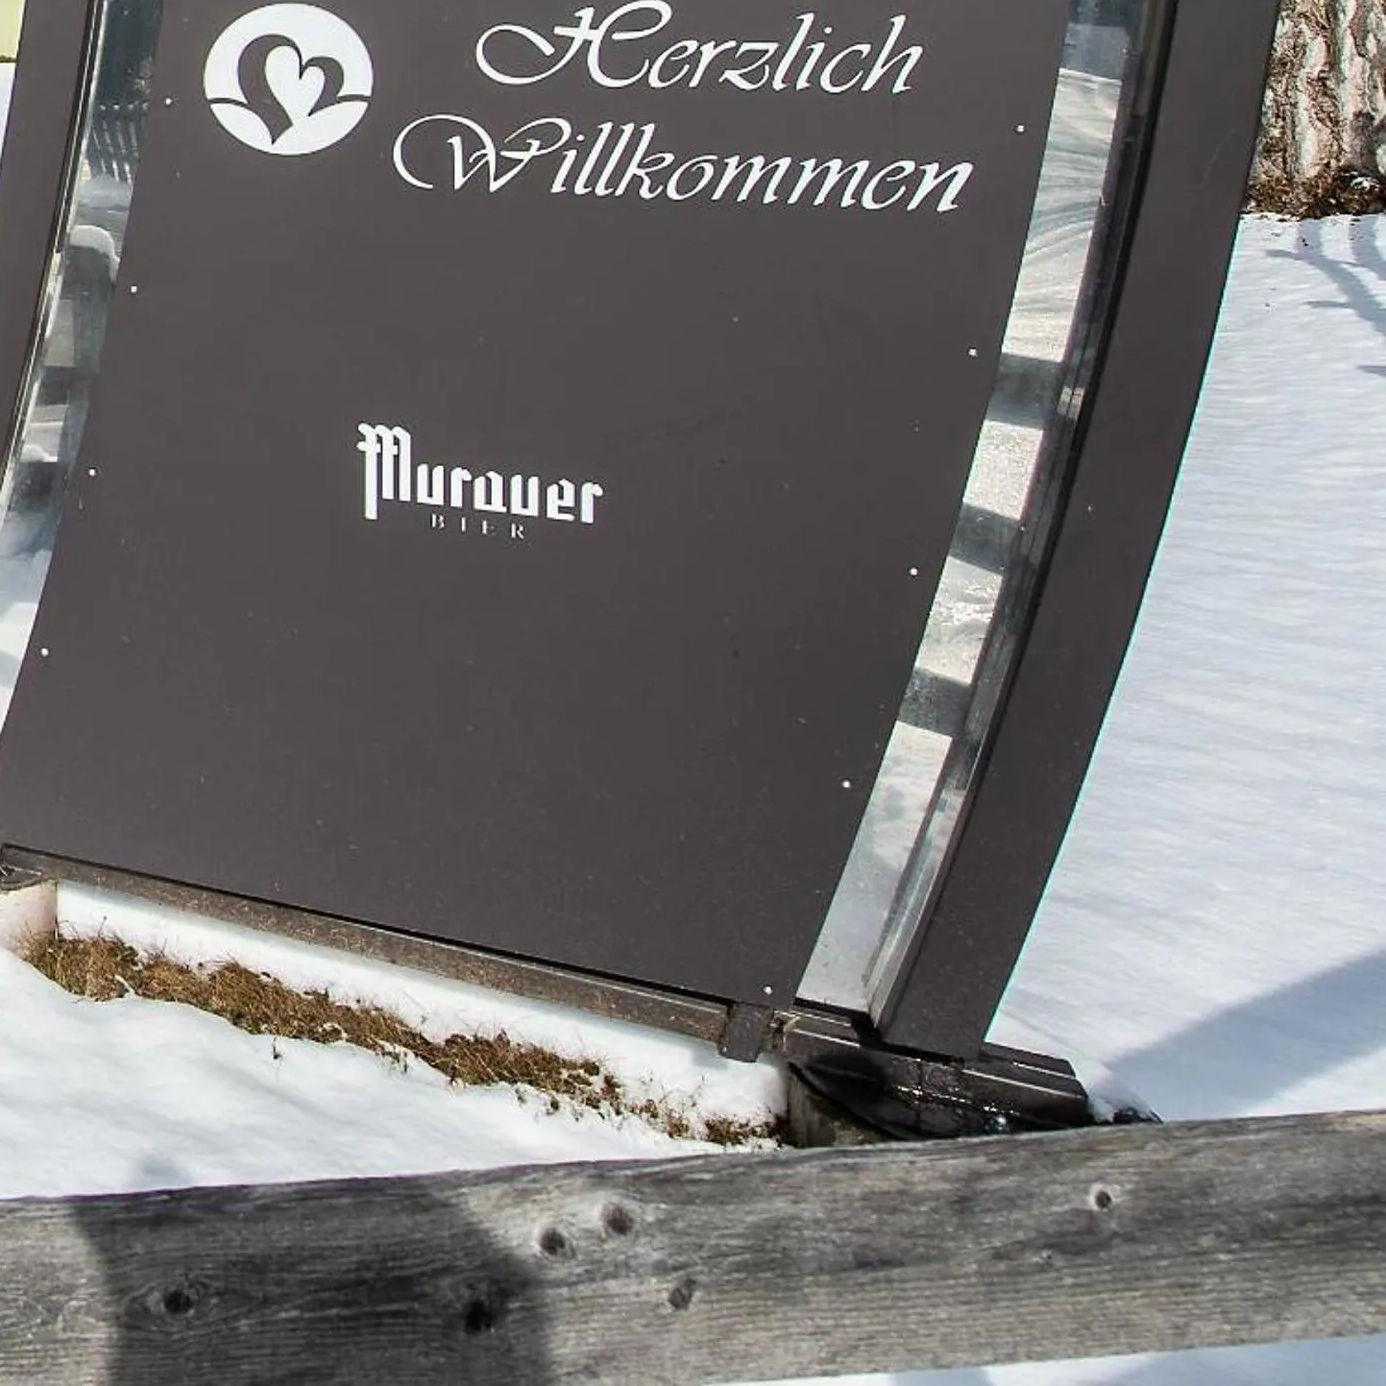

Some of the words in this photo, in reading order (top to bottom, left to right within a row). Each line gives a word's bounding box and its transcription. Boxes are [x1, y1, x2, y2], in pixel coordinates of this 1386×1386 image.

[475, 0, 923, 94] Herzlich
[392, 114, 973, 213] Willkommen
[356, 423, 604, 524] Murauer
[431, 514, 527, 540] BIER
